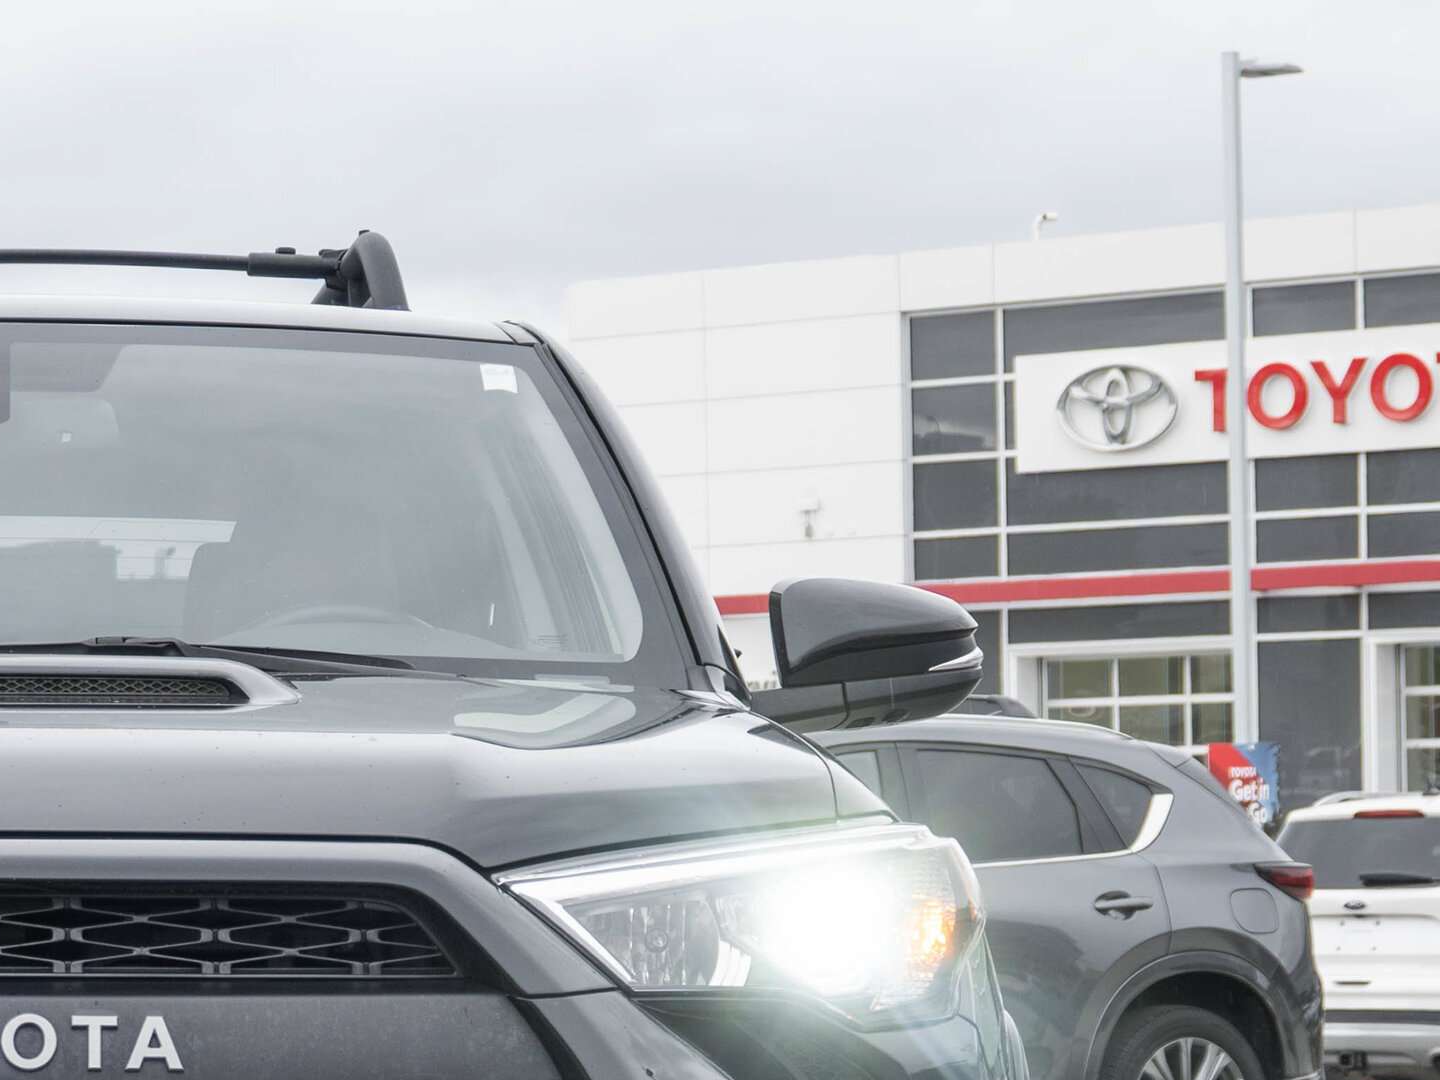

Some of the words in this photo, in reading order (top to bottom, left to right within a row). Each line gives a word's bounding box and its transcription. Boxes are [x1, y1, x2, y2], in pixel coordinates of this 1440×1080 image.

[1194, 352, 1440, 433] TOYO
[1230, 779, 1257, 801] Get
[1257, 777, 1270, 801] in
